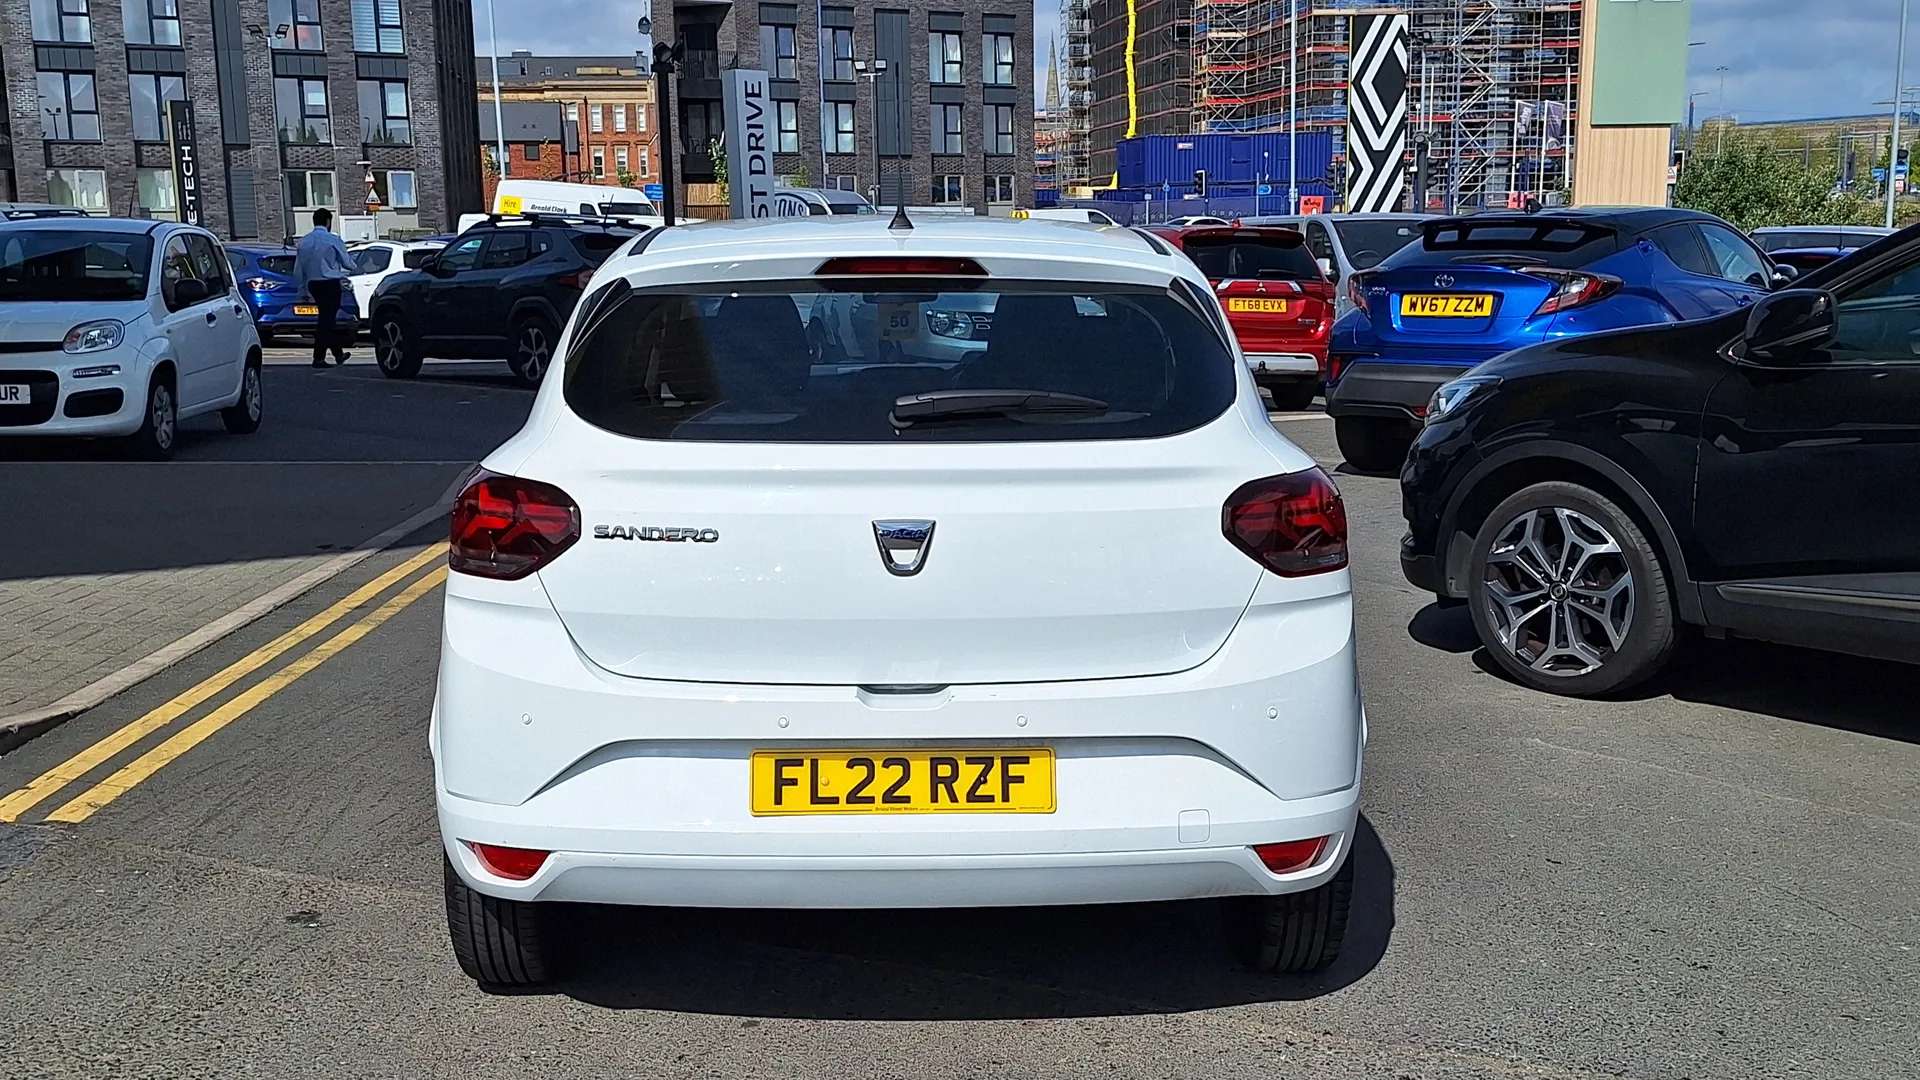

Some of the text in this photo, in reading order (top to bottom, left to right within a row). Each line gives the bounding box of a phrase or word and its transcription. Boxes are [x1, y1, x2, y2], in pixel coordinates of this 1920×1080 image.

[744, 80, 766, 176] DRIVE
[181, 146, 198, 226] E-TECH
[1234, 300, 1283, 310] FT68 EVX
[1408, 296, 1485, 312] WV67 ZZM
[594, 524, 719, 542] SANDERO
[774, 756, 1030, 805] FL22 RZF
